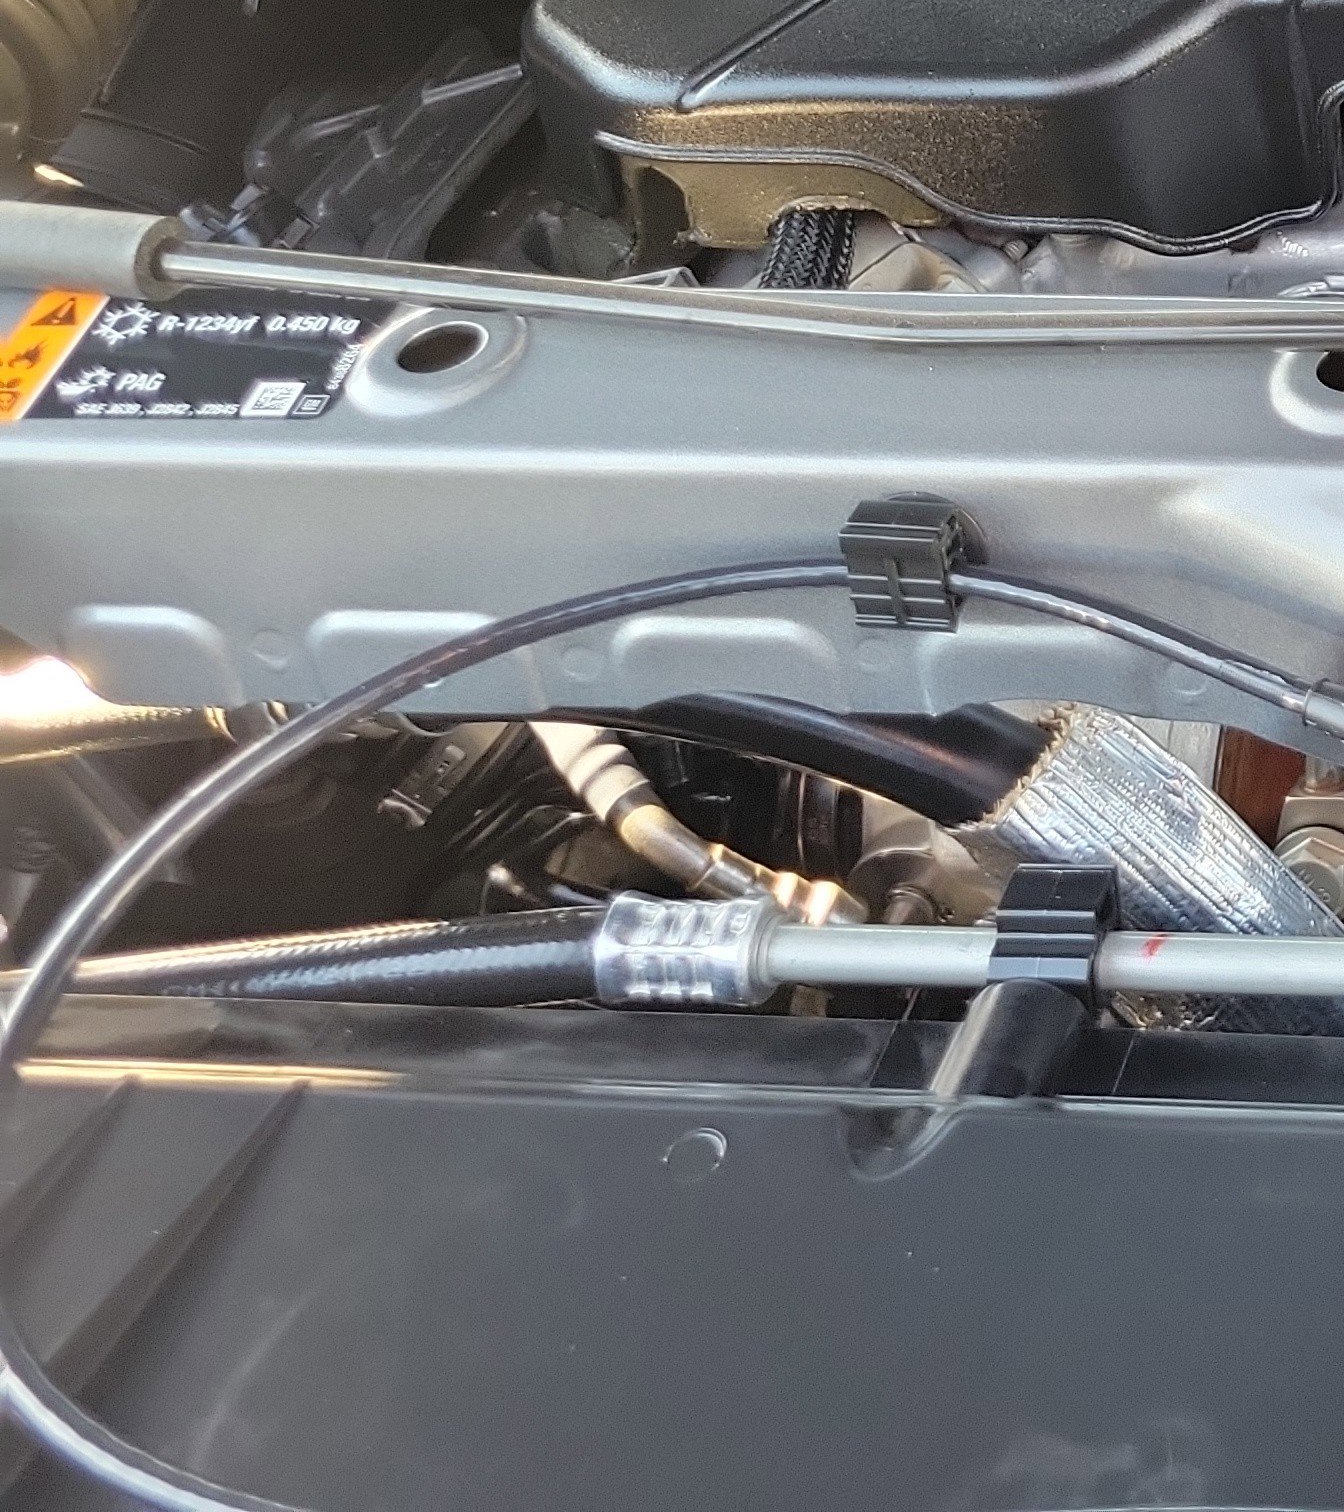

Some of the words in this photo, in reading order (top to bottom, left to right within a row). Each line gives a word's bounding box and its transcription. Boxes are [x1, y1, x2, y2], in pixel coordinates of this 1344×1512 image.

[158, 314, 260, 334] R-1234yf
[266, 315, 330, 332] 0.450
[329, 314, 361, 335] kg
[115, 371, 167, 391] PAG
